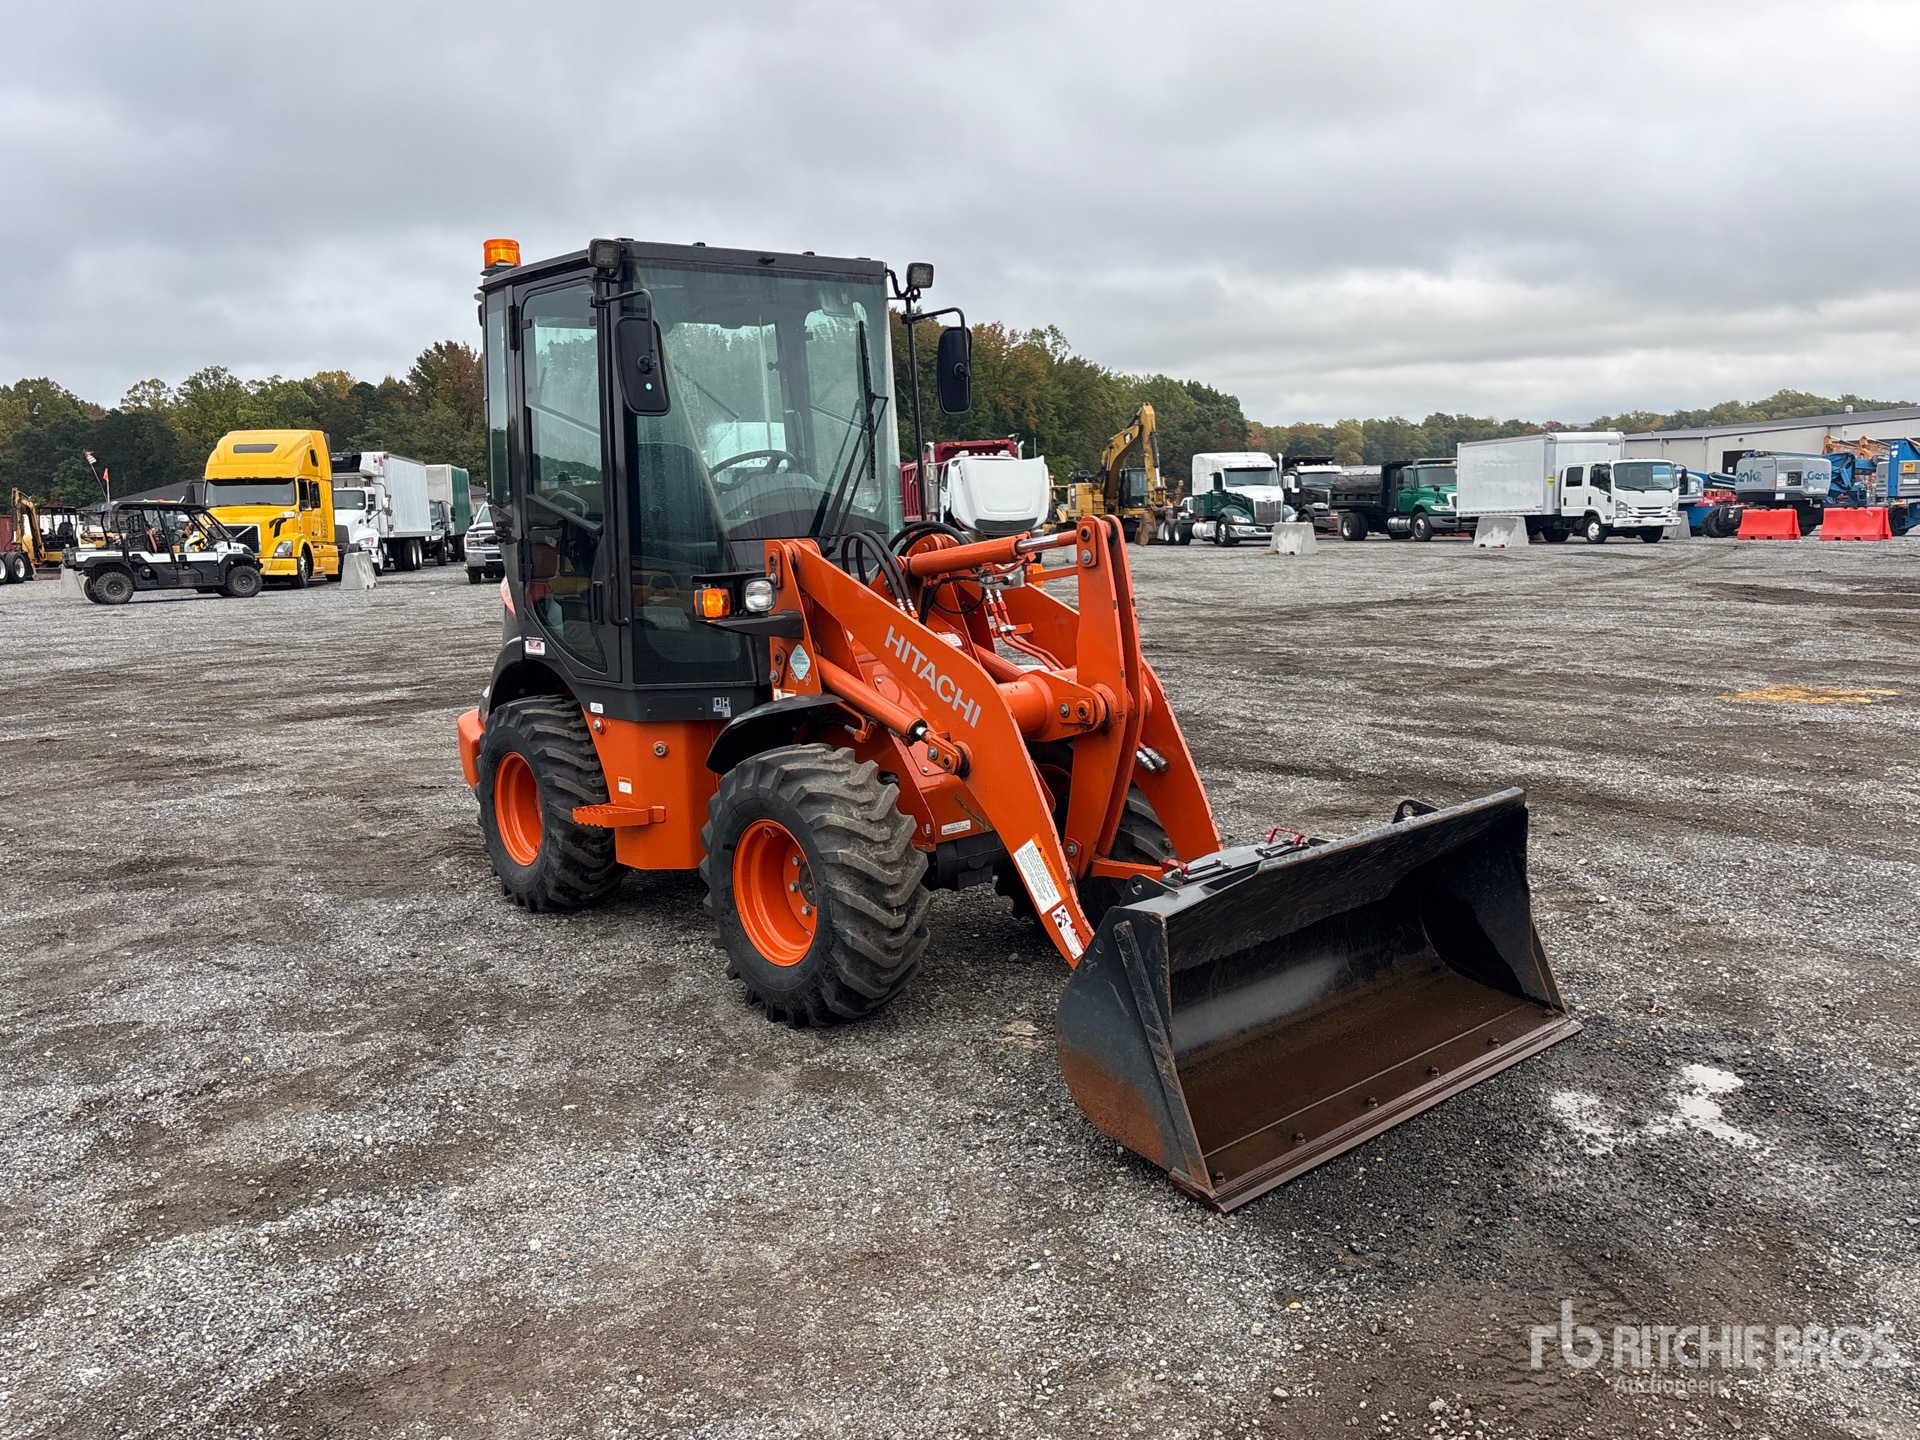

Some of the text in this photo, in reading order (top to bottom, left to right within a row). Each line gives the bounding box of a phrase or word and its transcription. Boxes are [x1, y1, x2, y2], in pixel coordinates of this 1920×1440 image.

[1807, 470, 1830, 481] Genie
[884, 625, 982, 728] HITACHI
[1041, 855, 1059, 886] WARNING
